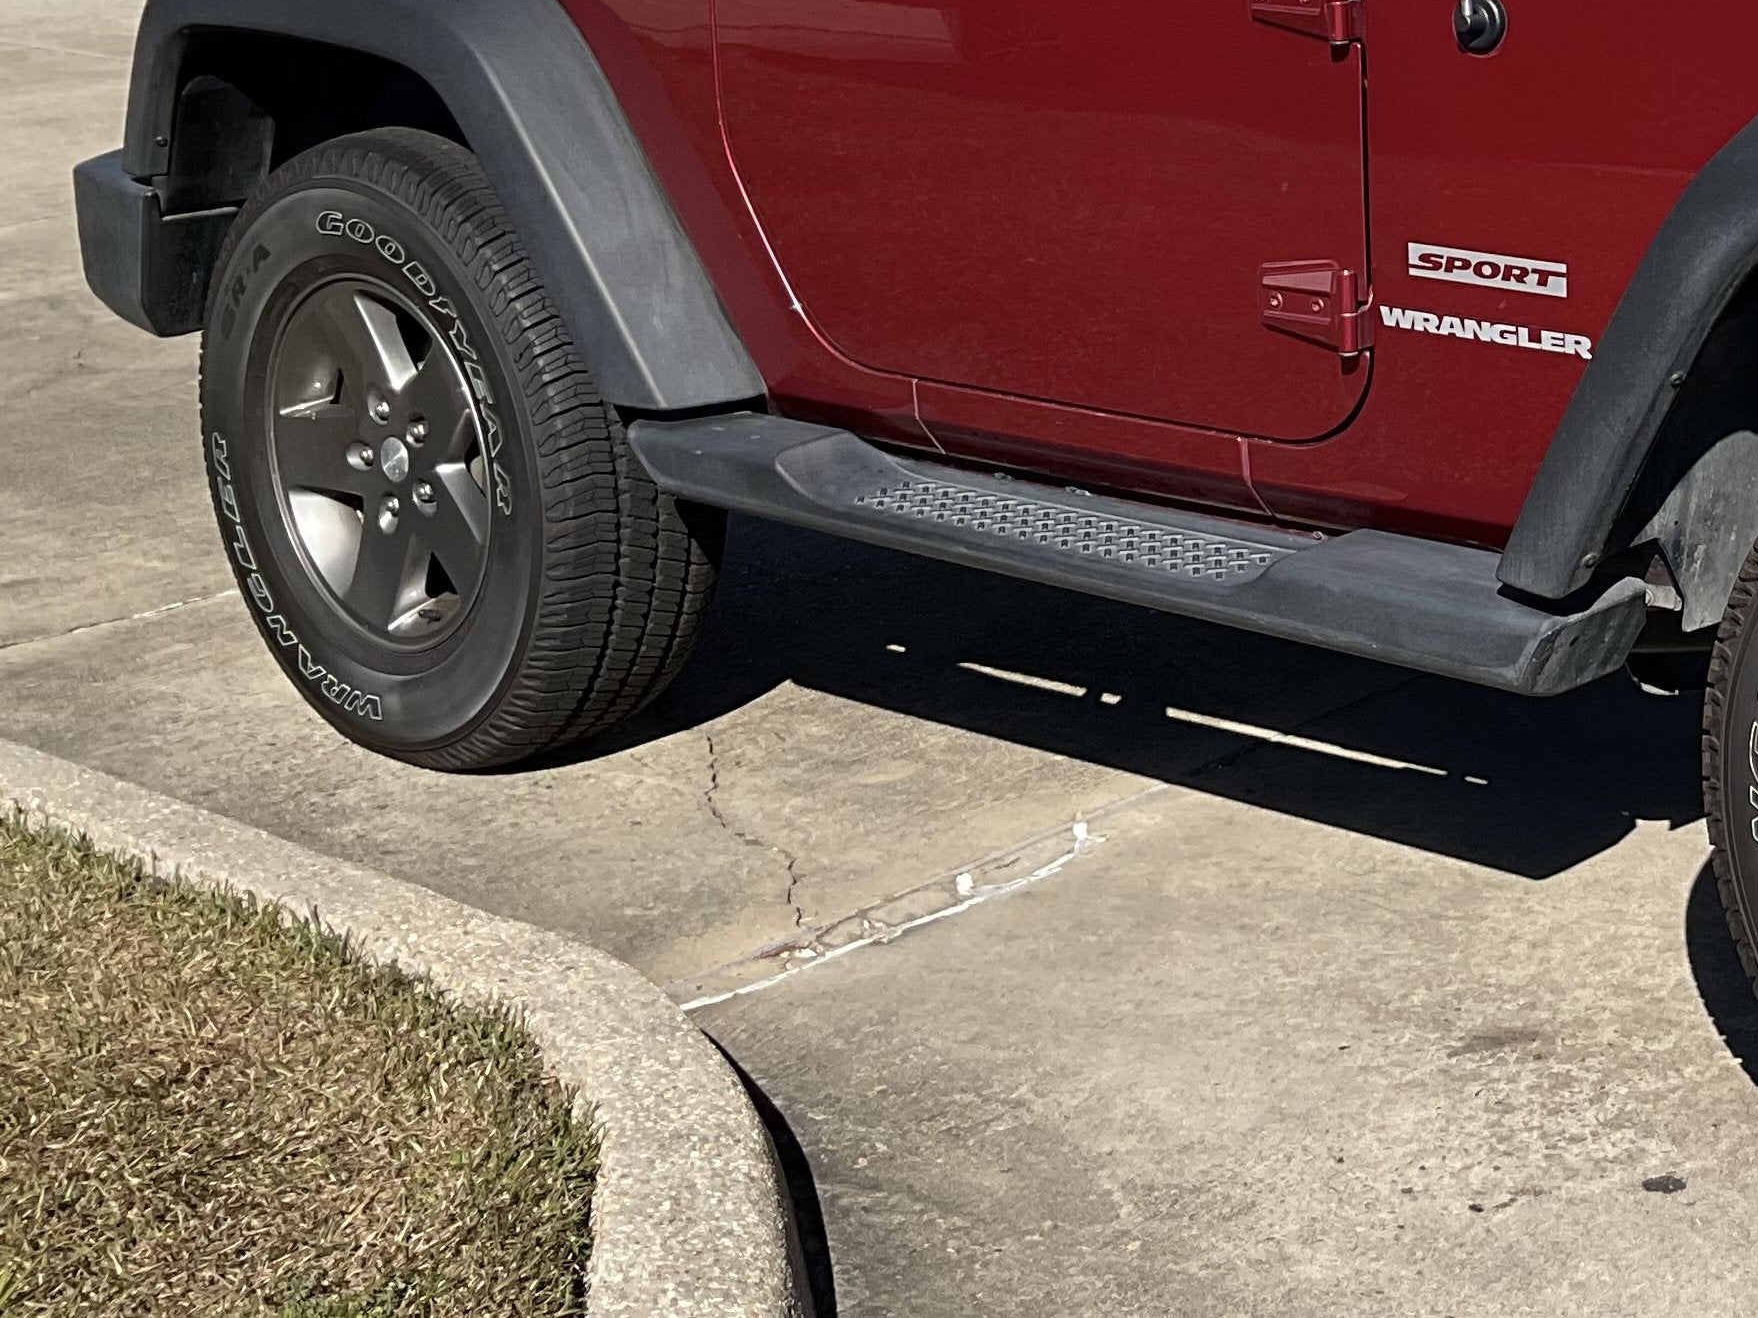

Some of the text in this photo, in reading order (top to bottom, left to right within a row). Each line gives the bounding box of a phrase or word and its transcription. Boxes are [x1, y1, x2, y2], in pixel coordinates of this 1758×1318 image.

[1379, 304, 1593, 360] WRANGLER
[1409, 252, 1566, 288] SPORT
[315, 209, 512, 516] GOODYEAR
[212, 431, 384, 721] WRANGLER
